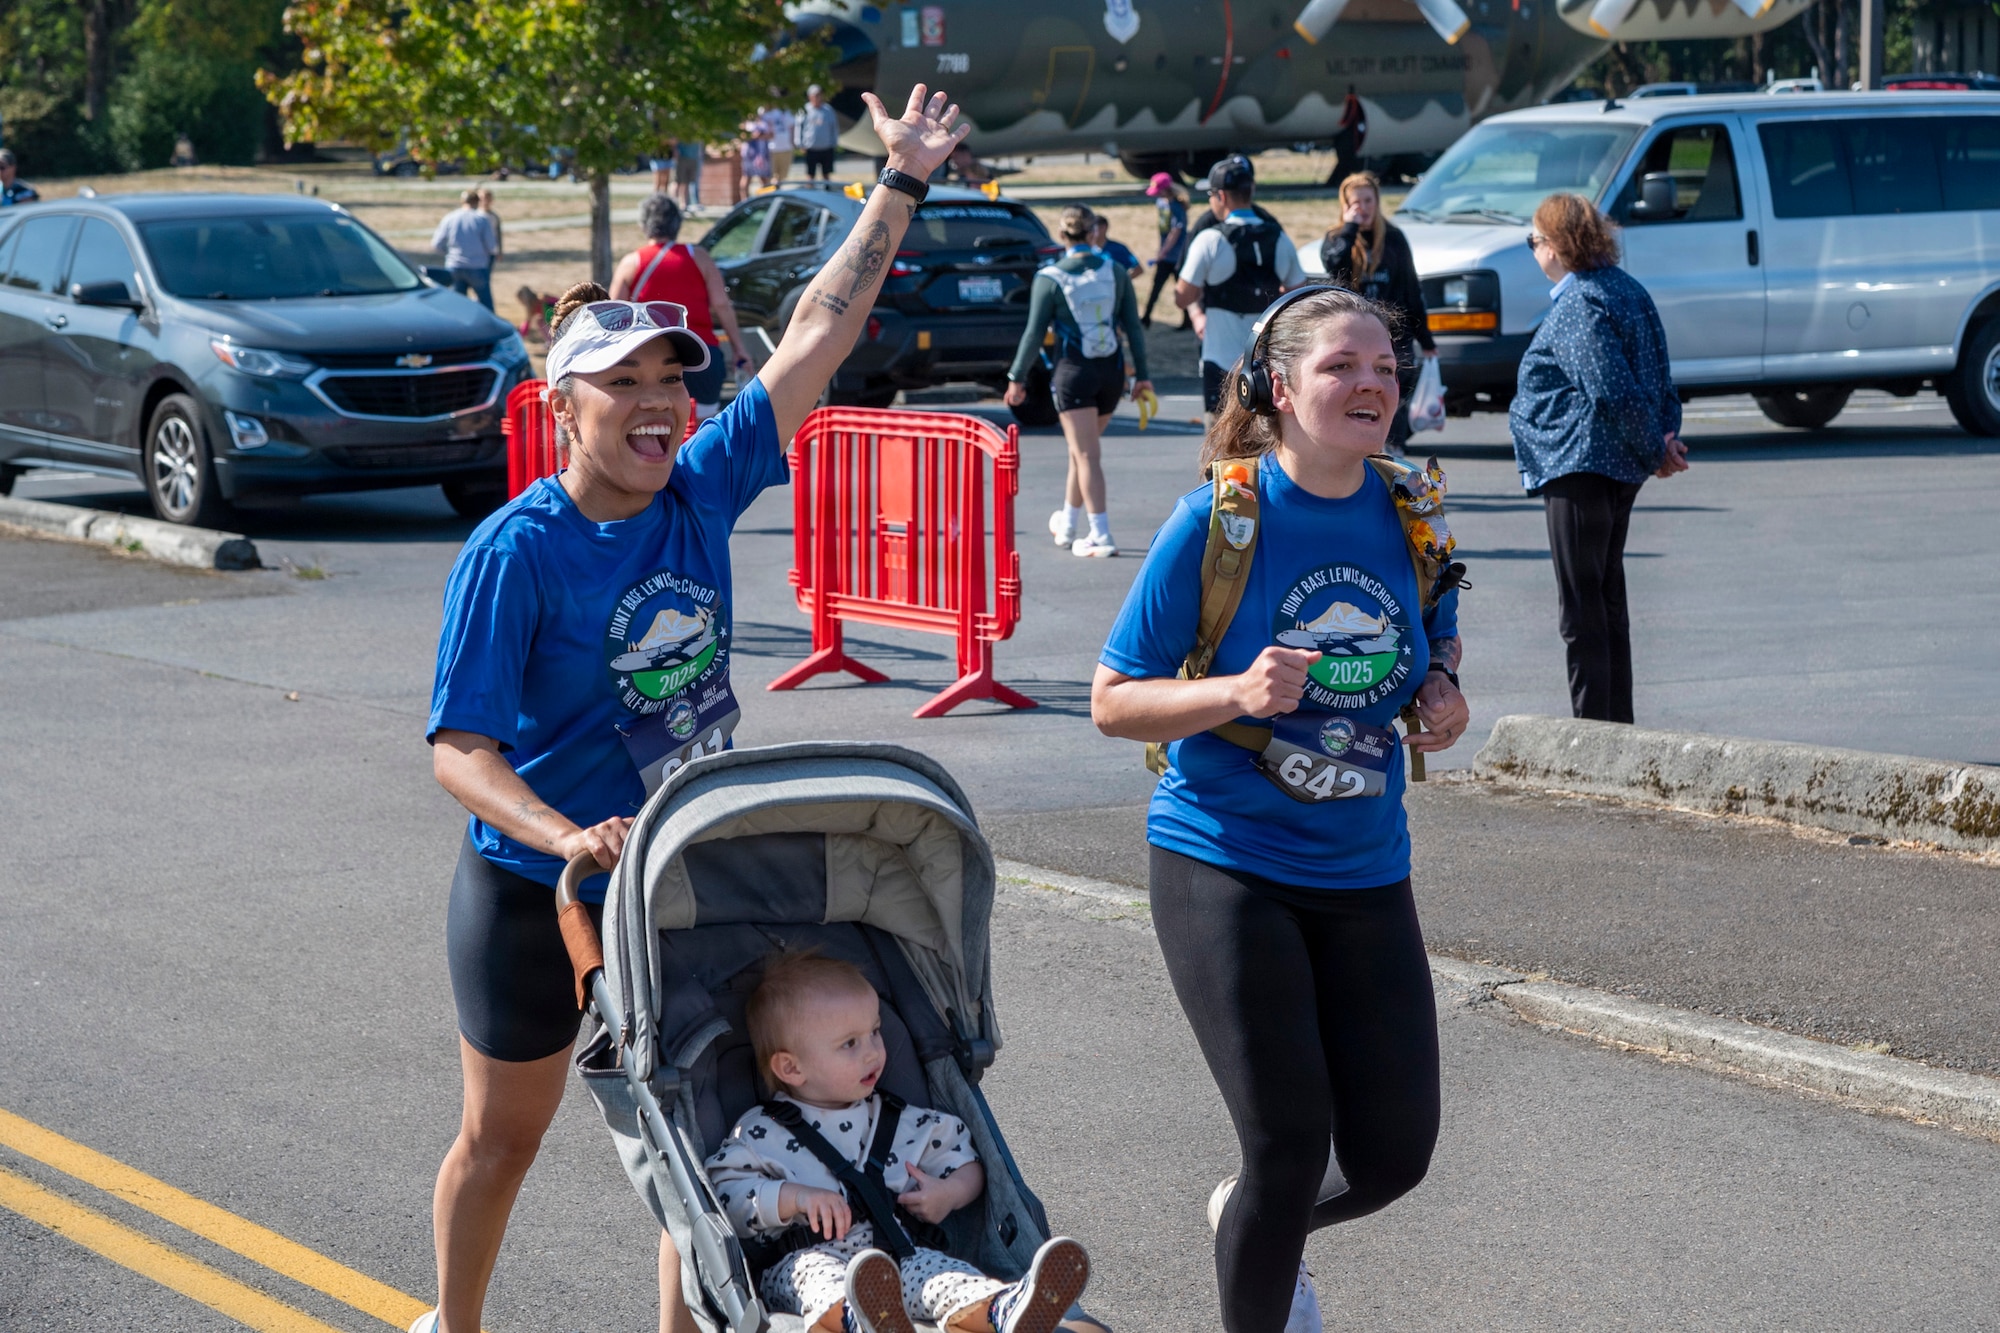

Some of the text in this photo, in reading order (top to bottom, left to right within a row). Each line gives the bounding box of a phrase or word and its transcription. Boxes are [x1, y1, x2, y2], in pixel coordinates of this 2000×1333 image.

[1280, 587, 1306, 618] JOINT
[1300, 570, 1329, 595] BASE
[609, 606, 631, 641] JOINT
[622, 588, 646, 611] BASE
[659, 661, 698, 696] 2025
[1303, 662, 1410, 709] F-MARATHON & 5K/1K
[1329, 661, 1373, 685] 2025
[697, 688, 729, 715] MARATHON
[702, 684, 717, 701] HALF
[1353, 740, 1384, 758] MARATHON
[1279, 752, 1366, 800] 642
